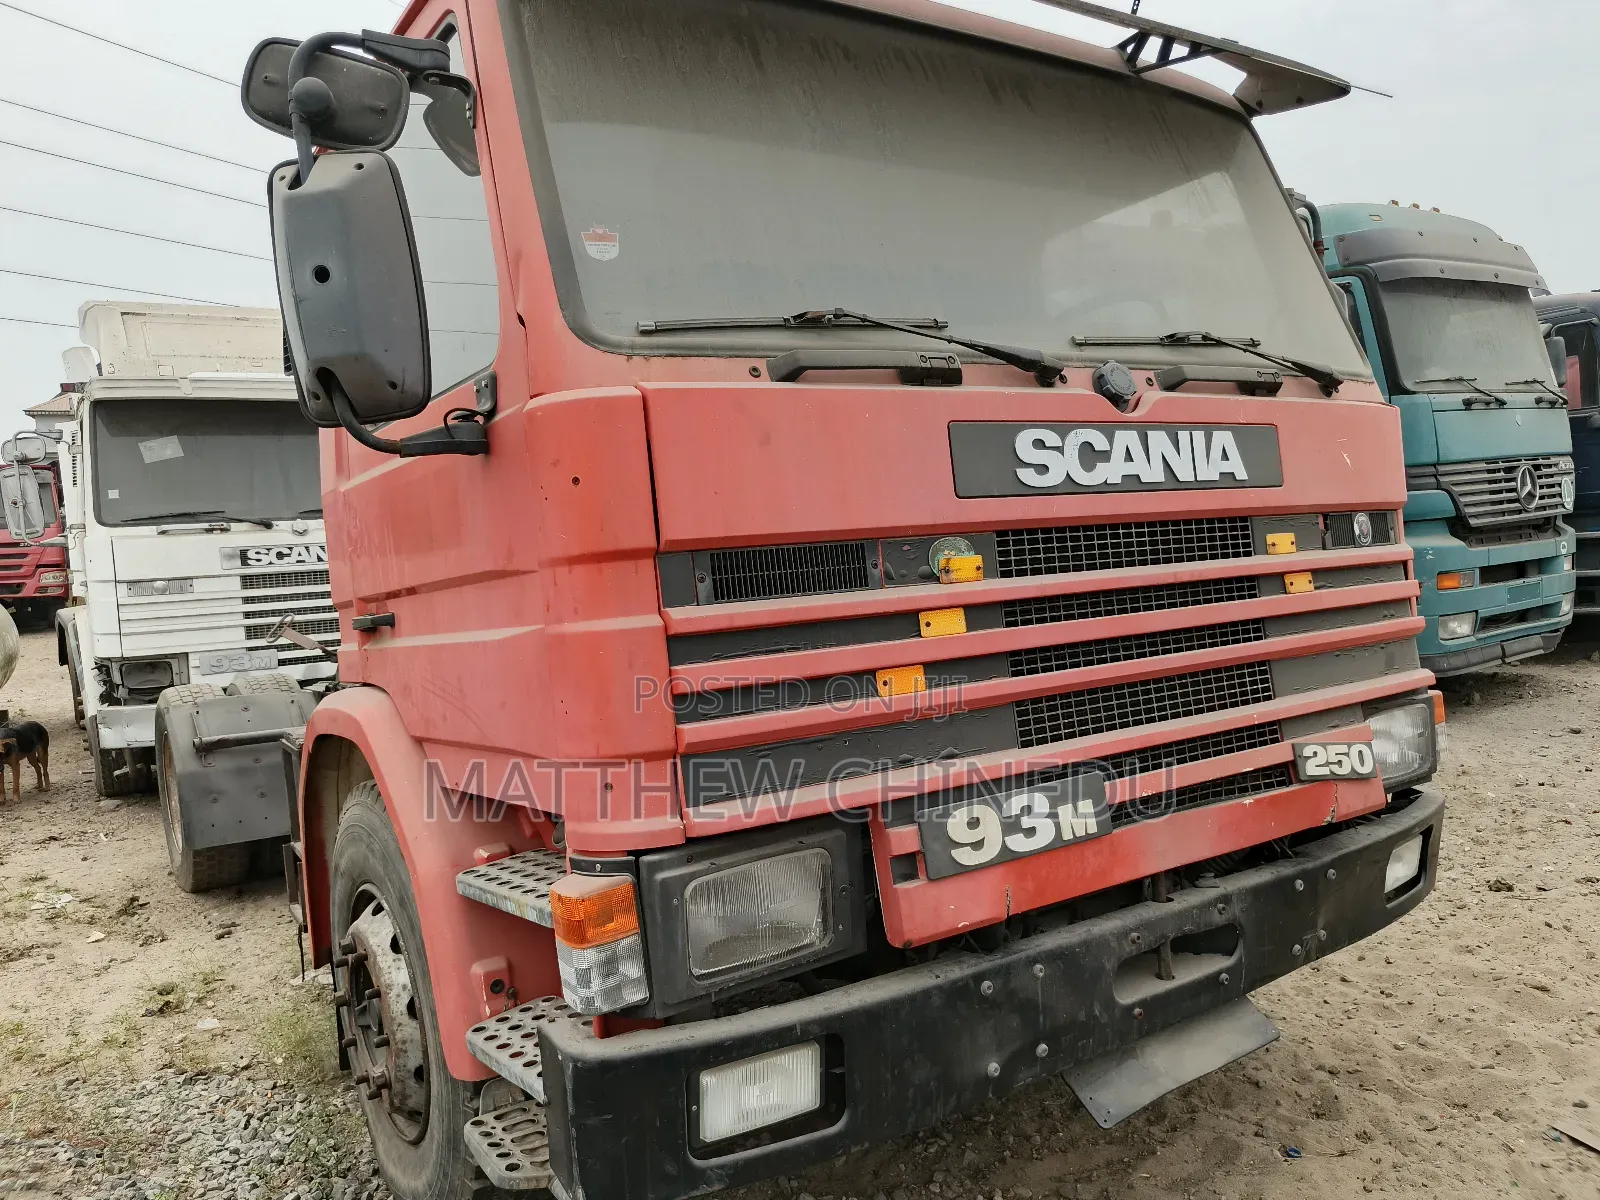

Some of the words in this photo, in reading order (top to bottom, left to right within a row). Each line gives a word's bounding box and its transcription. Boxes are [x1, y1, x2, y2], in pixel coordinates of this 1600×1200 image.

[1013, 428, 1249, 488] SCANIA
[246, 545, 328, 566] SCAN
[1302, 743, 1375, 776] 250
